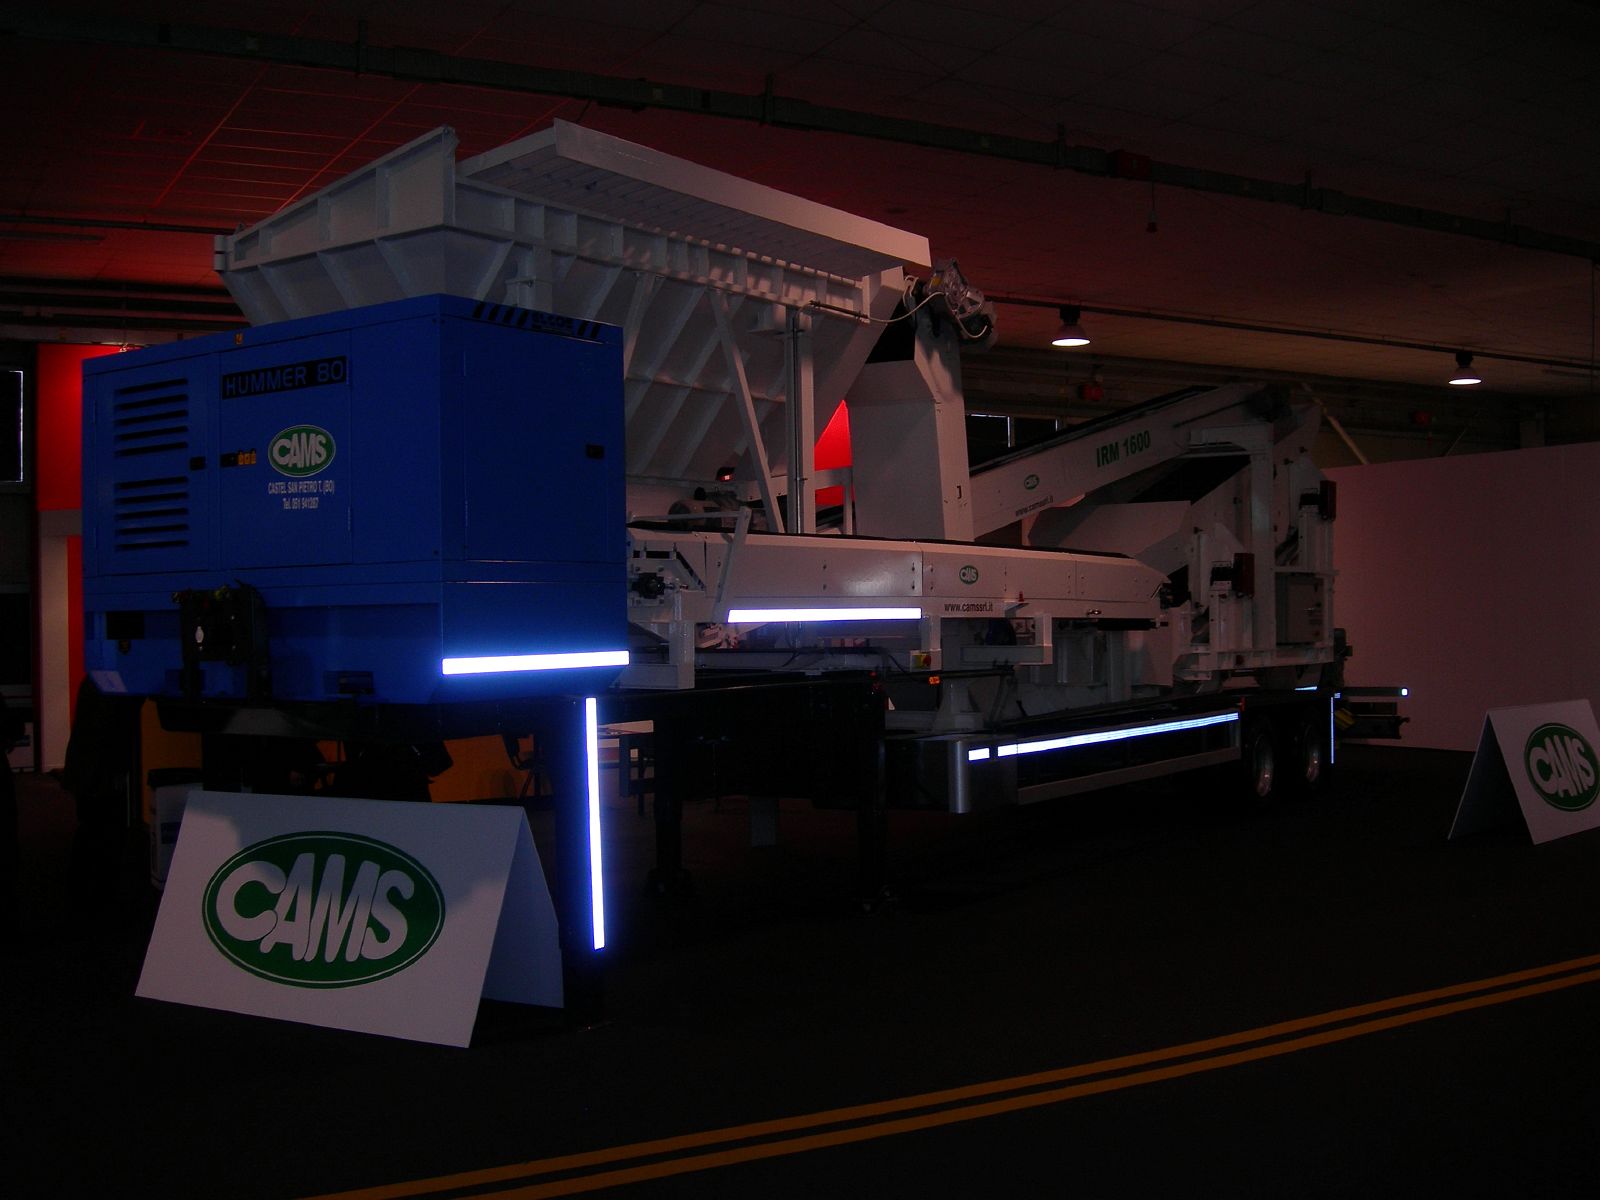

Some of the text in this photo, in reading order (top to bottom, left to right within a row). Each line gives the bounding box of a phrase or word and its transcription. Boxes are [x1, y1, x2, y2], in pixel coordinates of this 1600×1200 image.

[225, 360, 344, 396] HUMMER 80
[272, 432, 327, 468] CAMS
[1096, 430, 1151, 467] IRM 1600
[268, 482, 287, 494] CASTEL
[287, 481, 298, 494] SAN
[944, 601, 994, 612] www.camssrl.it
[1529, 734, 1596, 798] CAMS
[216, 852, 415, 964] CAMS
